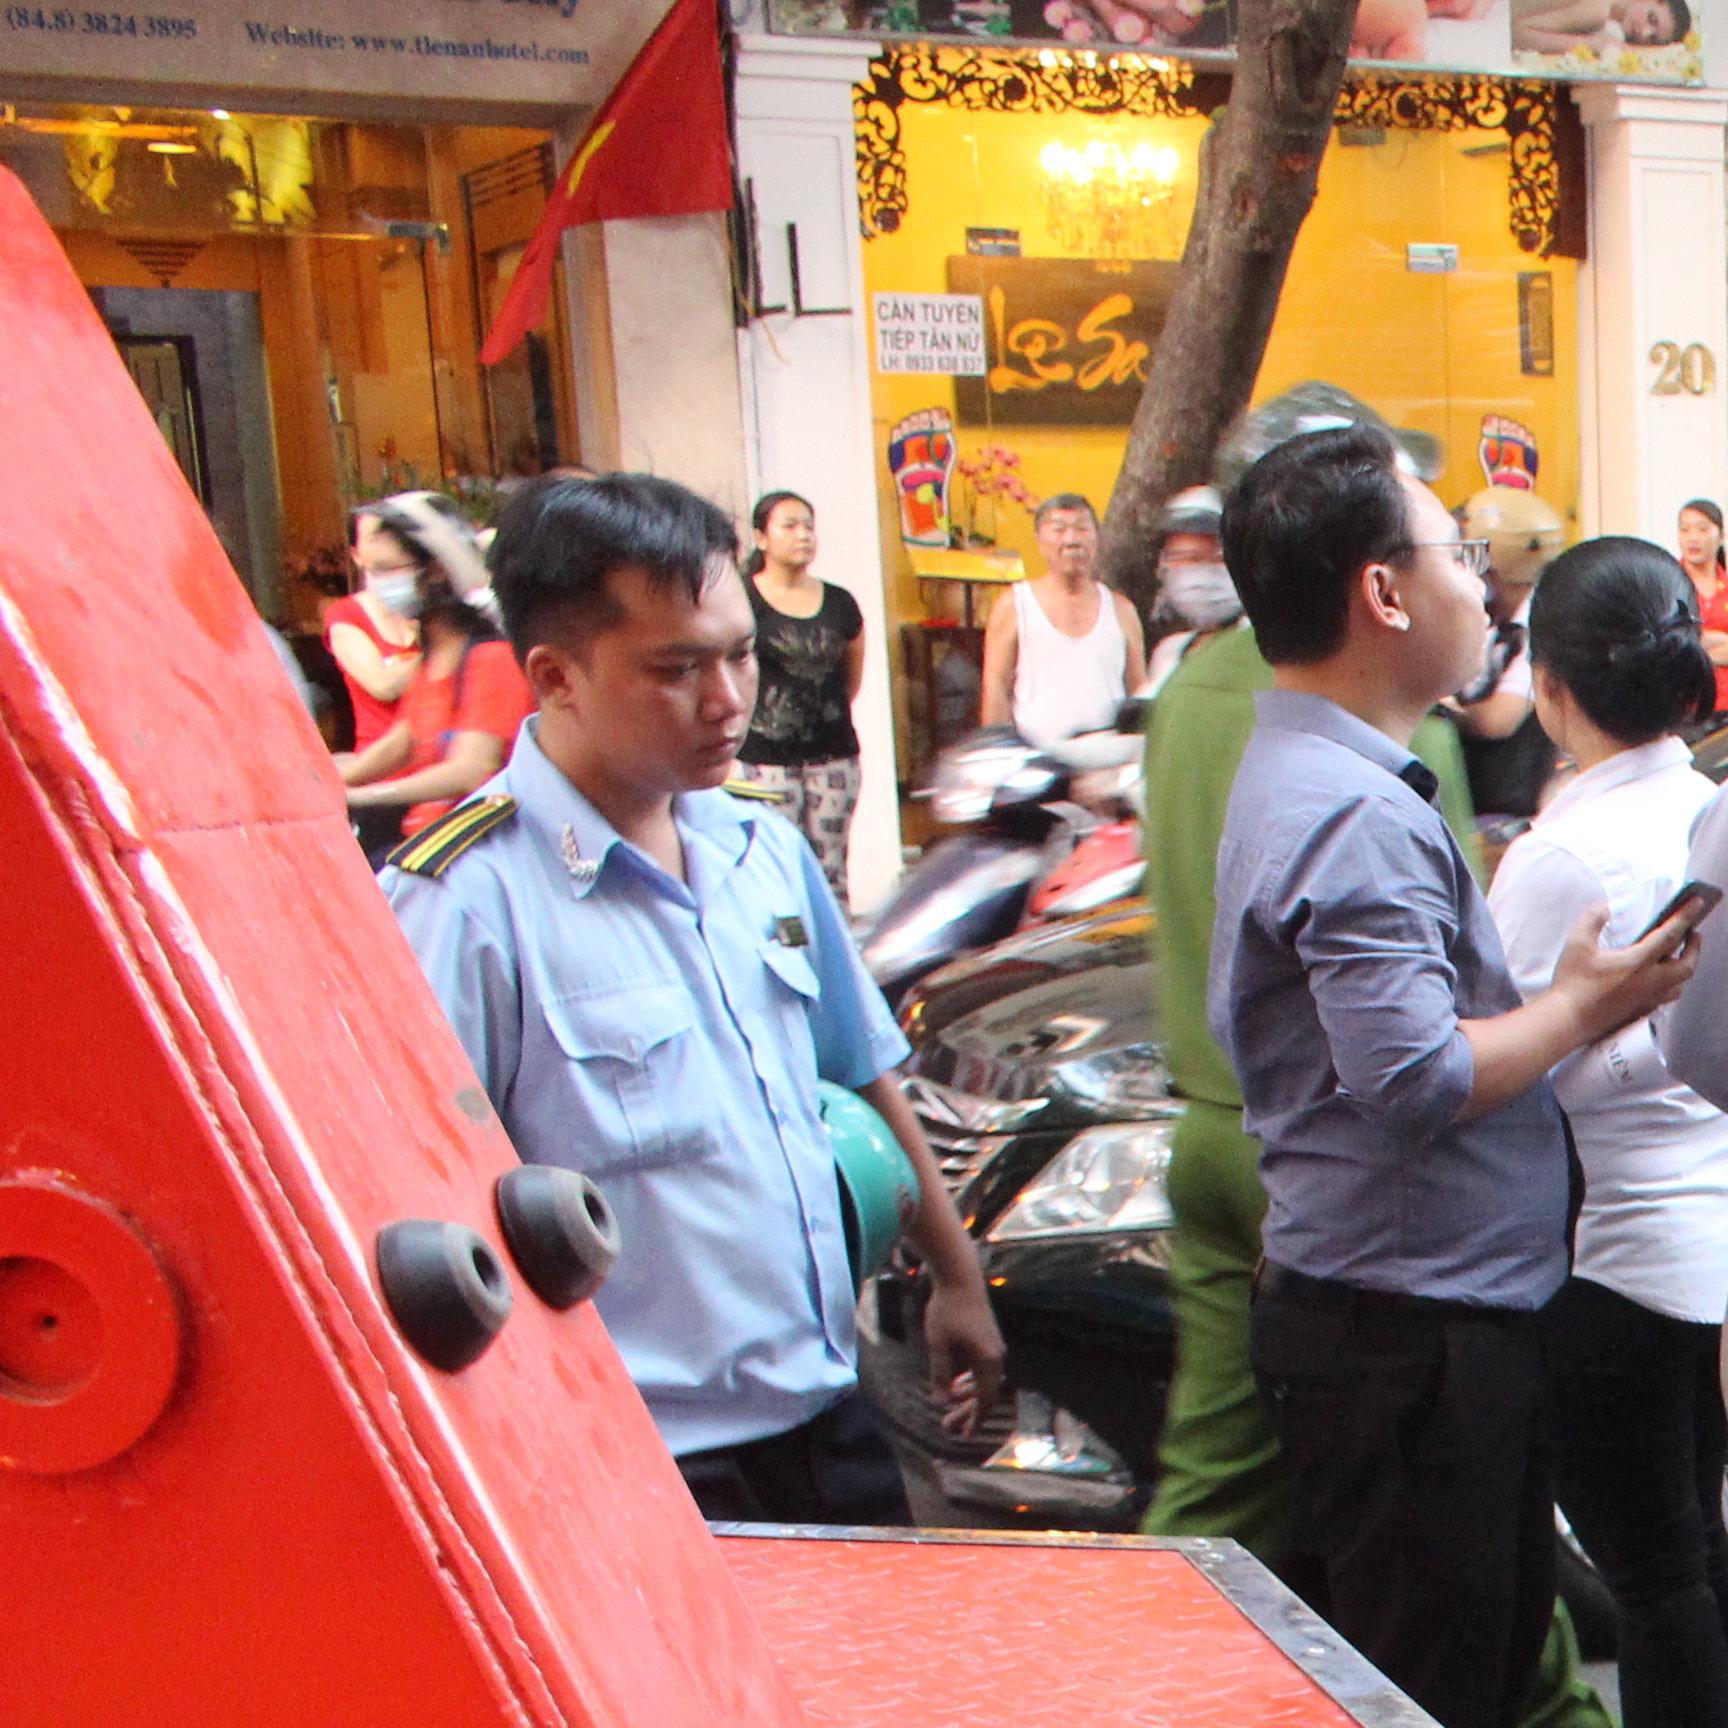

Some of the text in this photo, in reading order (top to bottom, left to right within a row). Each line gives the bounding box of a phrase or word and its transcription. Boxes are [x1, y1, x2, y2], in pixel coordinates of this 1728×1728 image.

[82, 12, 137, 36] 3824
[243, 21, 344, 50] Website:
[1649, 342, 1717, 397] 20
